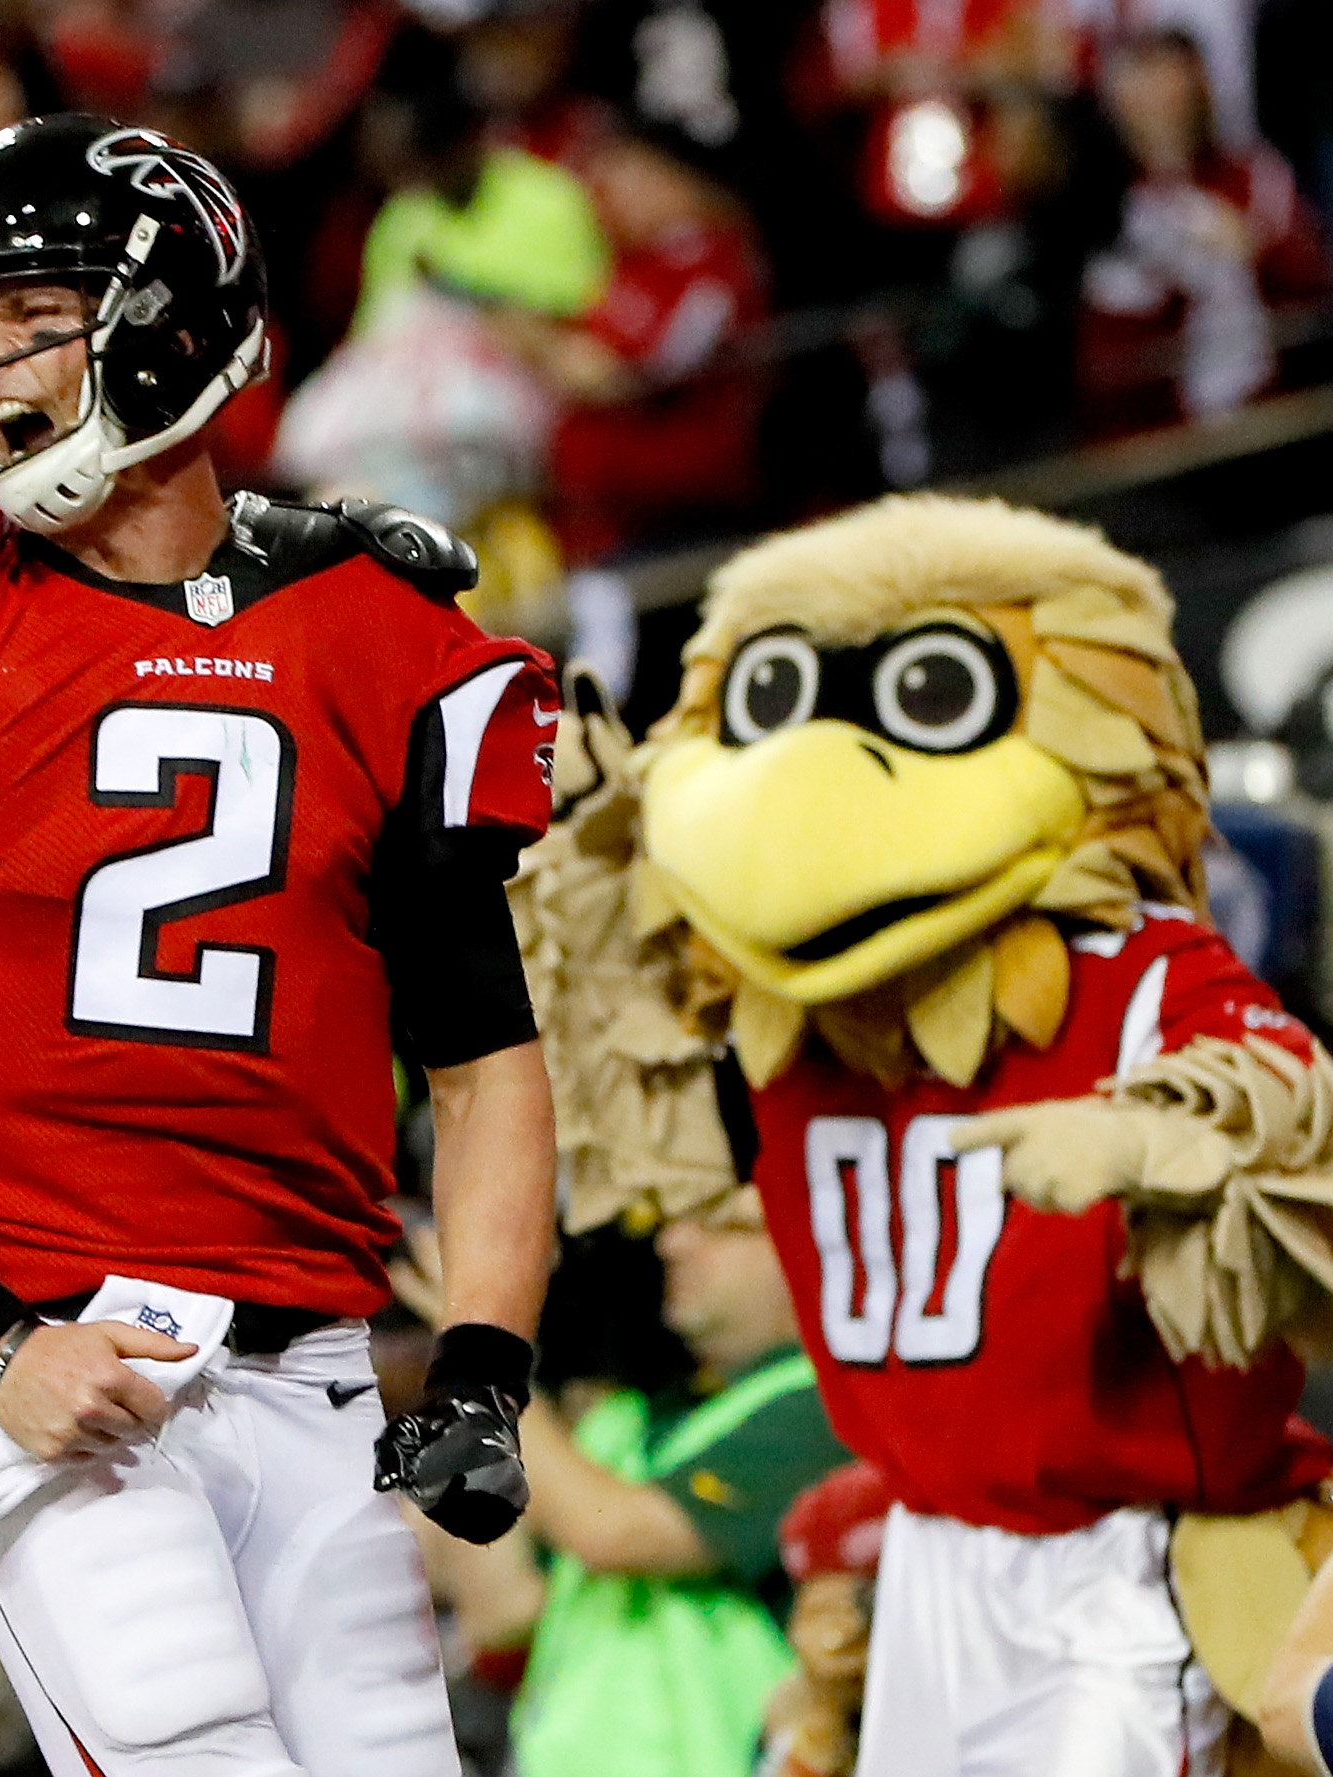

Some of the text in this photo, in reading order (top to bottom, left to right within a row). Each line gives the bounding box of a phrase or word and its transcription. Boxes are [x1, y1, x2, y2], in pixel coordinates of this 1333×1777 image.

[134, 657, 275, 682] FALCONS
[194, 595, 227, 616] NFL
[68, 703, 292, 1046] 2
[804, 1114, 1004, 1365] 00
